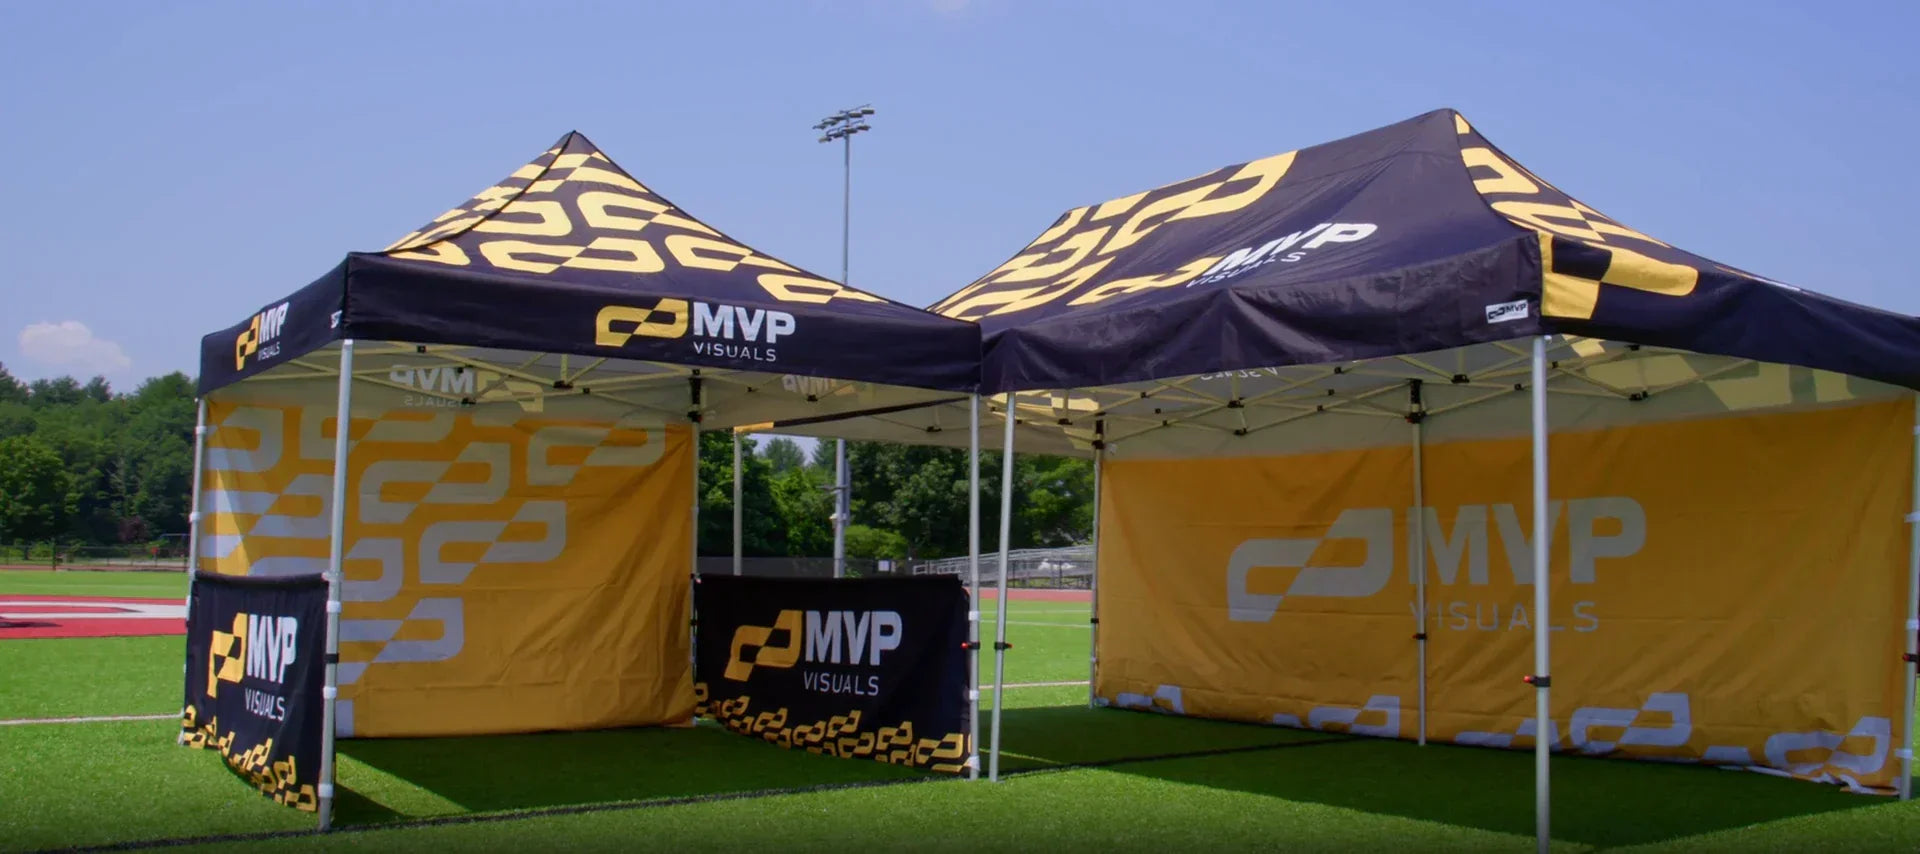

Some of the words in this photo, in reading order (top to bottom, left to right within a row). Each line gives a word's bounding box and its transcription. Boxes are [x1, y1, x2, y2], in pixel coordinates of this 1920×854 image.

[1186, 252, 1307, 288] VISUALS
[1202, 223, 1378, 276] MVP
[259, 302, 290, 344] MVP
[693, 301, 796, 344] MVP
[1505, 303, 1527, 312] MVP
[693, 341, 777, 362] VISUALS
[1407, 496, 1646, 585] MVP
[246, 614, 297, 684] MVP
[805, 610, 902, 666] MVP
[245, 687, 285, 721] VISUALS
[803, 671, 879, 696] VISUALS
